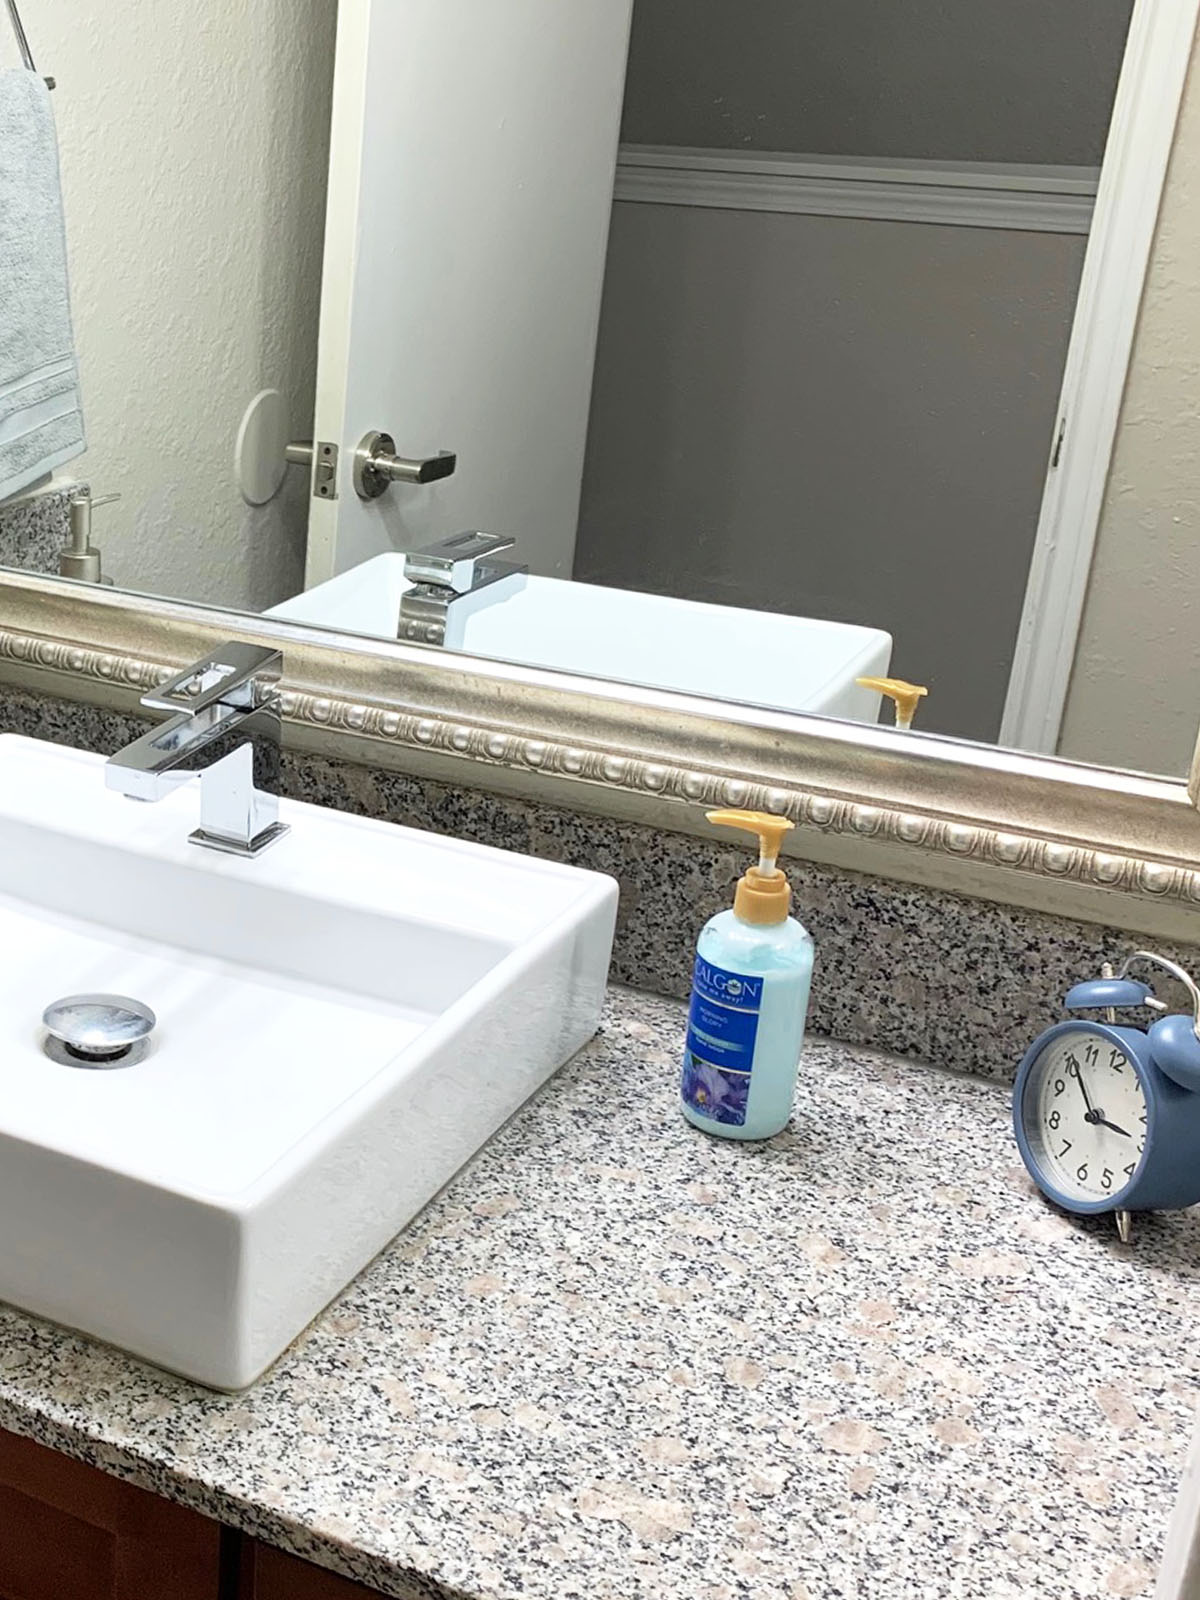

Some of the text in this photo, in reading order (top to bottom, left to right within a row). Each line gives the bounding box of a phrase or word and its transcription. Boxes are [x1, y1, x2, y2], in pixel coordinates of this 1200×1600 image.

[696, 958, 758, 997] CALGON
[1086, 1045, 1099, 1066] 11
[1110, 1049, 1127, 1073] 12
[1065, 1056, 1079, 1077] 10
[1055, 1080, 1065, 1097] 9
[1049, 1111, 1061, 1129] 8
[1059, 1139, 1072, 1157] 7
[1077, 1163, 1088, 1180] 6
[1101, 1168, 1114, 1188] 5
